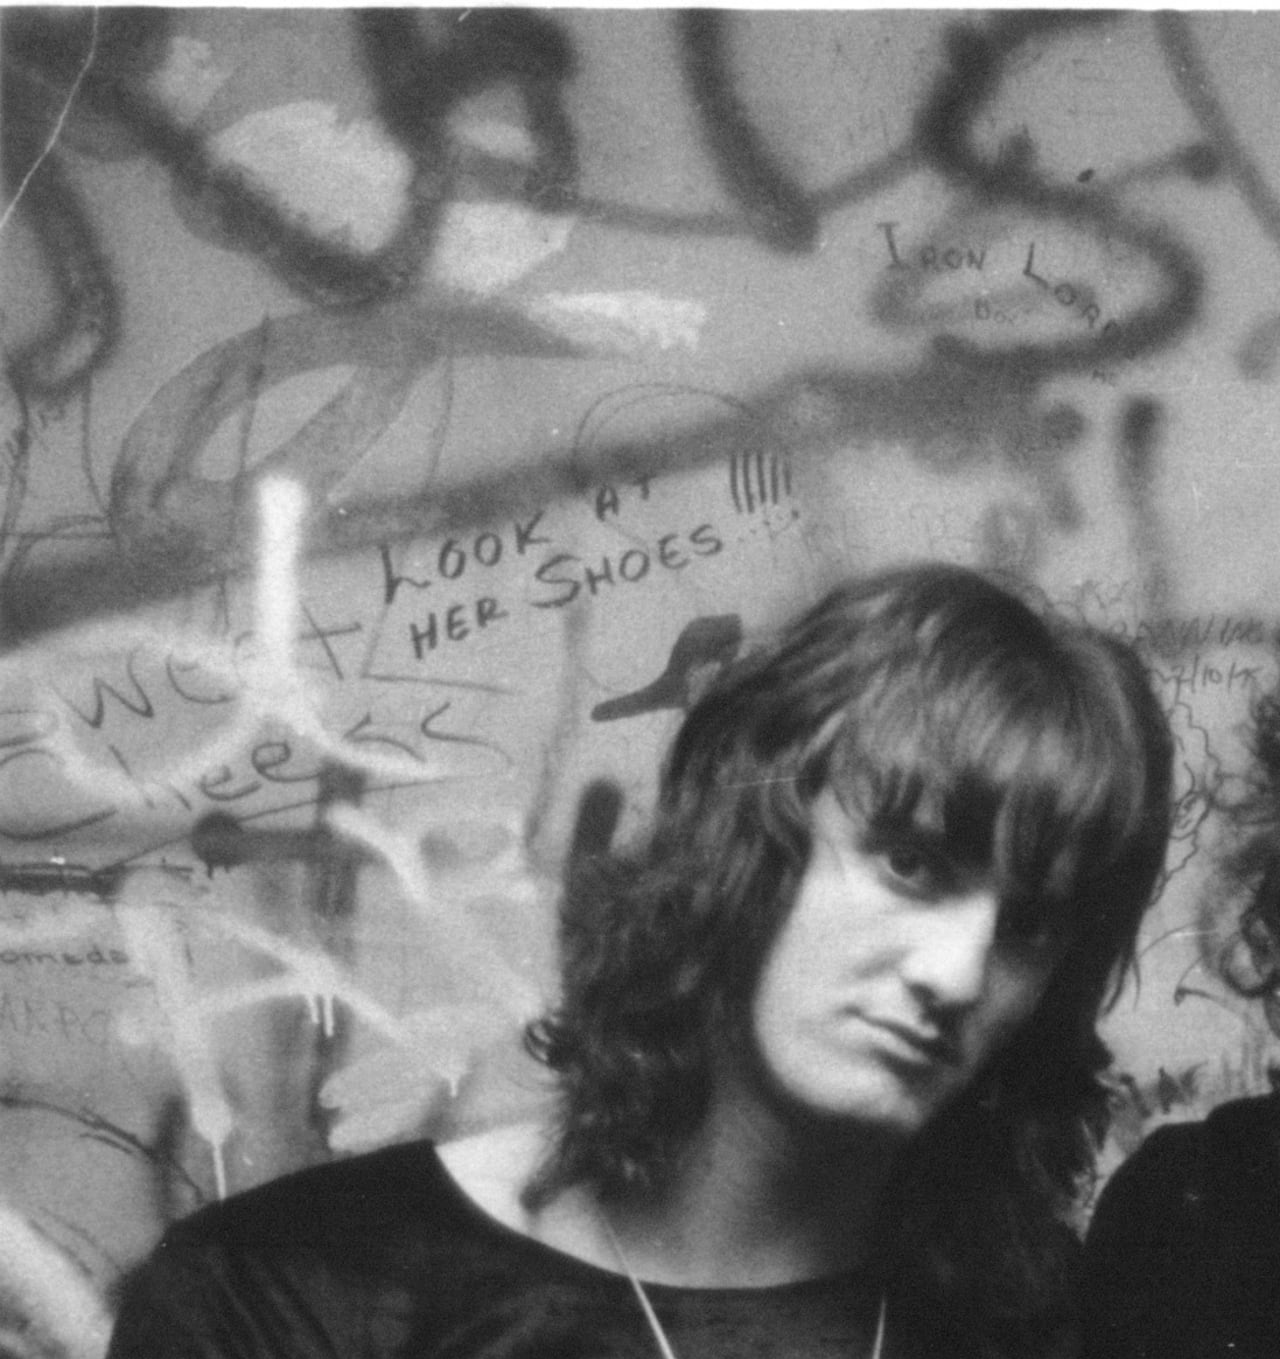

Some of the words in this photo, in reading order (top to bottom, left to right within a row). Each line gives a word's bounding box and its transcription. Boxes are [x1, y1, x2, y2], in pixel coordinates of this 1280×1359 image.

[381, 510, 552, 605] LOOK
[595, 471, 652, 521] AT
[410, 598, 508, 660] HER
